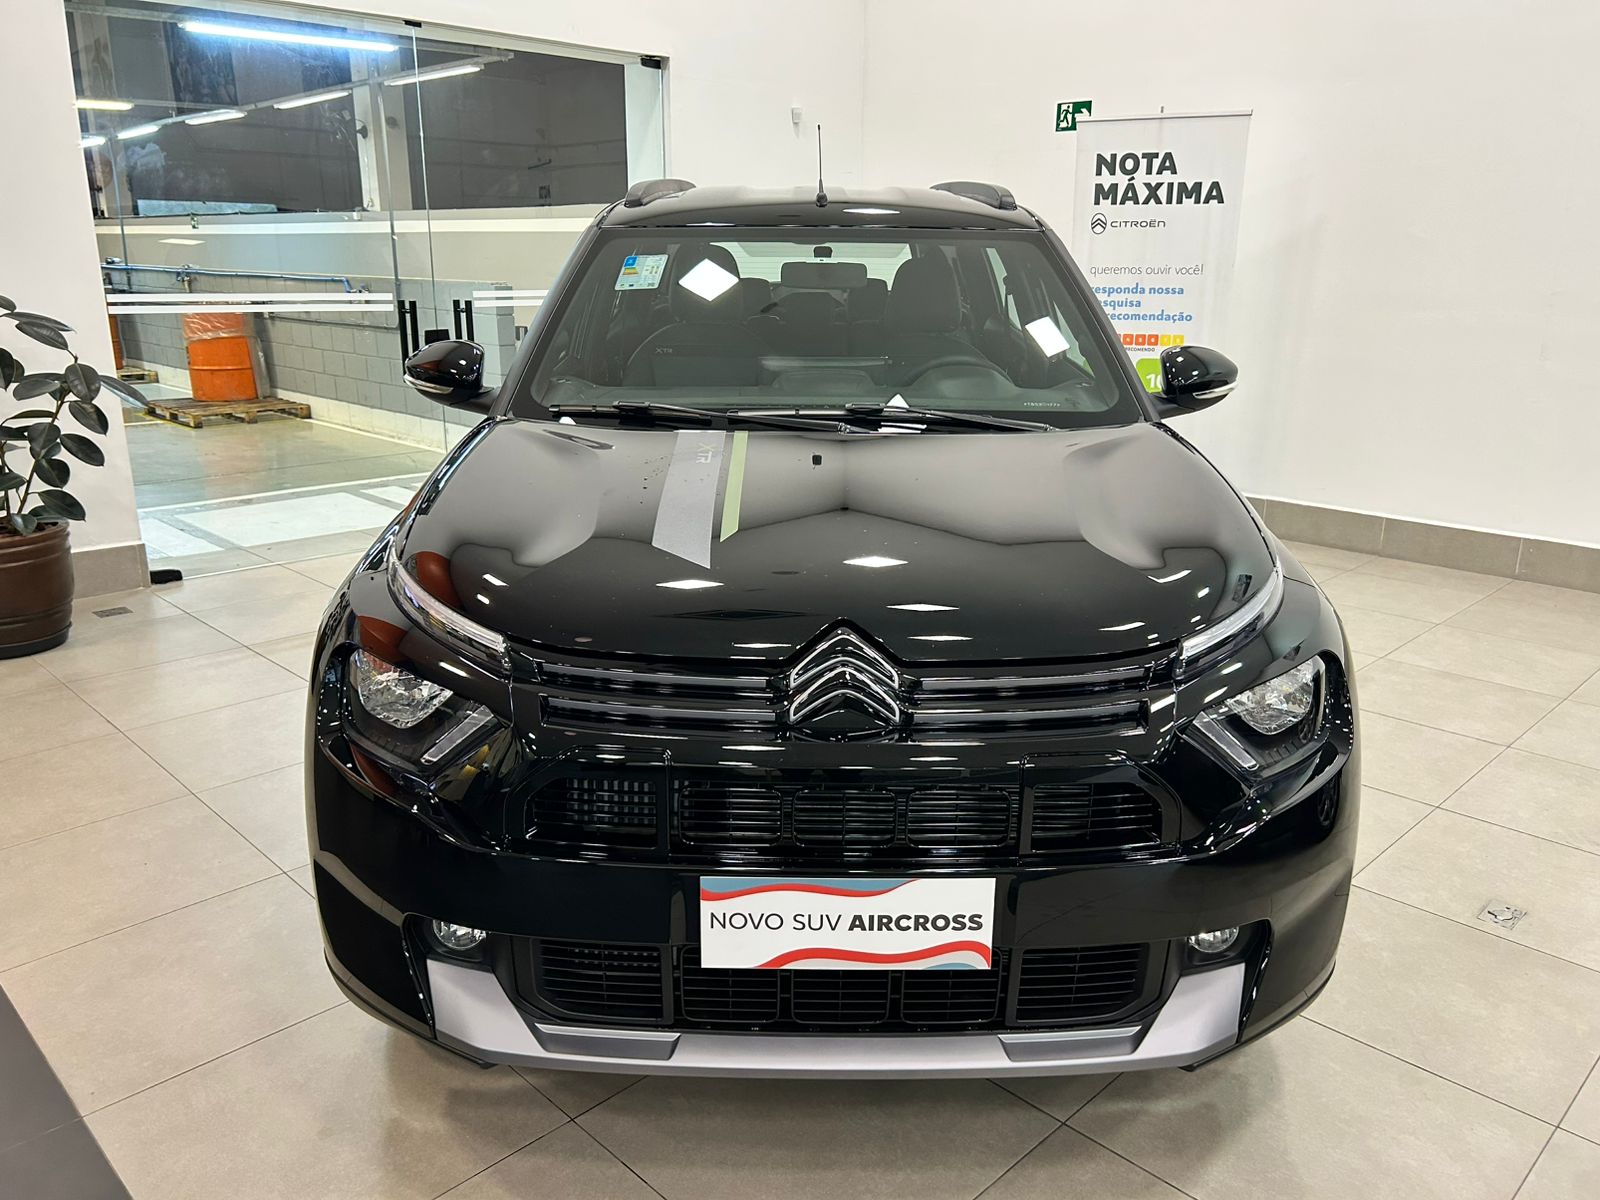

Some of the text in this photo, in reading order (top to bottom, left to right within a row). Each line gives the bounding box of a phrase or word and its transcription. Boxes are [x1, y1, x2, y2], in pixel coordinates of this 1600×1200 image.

[1095, 151, 1178, 177] NOTA
[1093, 175, 1225, 206] MÁXIMA
[1110, 218, 1166, 229] CITROËN
[1089, 264, 1204, 278] queremos ouvir você!
[1148, 287, 1185, 295] nossa
[696, 442, 716, 464] XTR
[709, 911, 984, 932] NOVO SUV AIRCROSS
